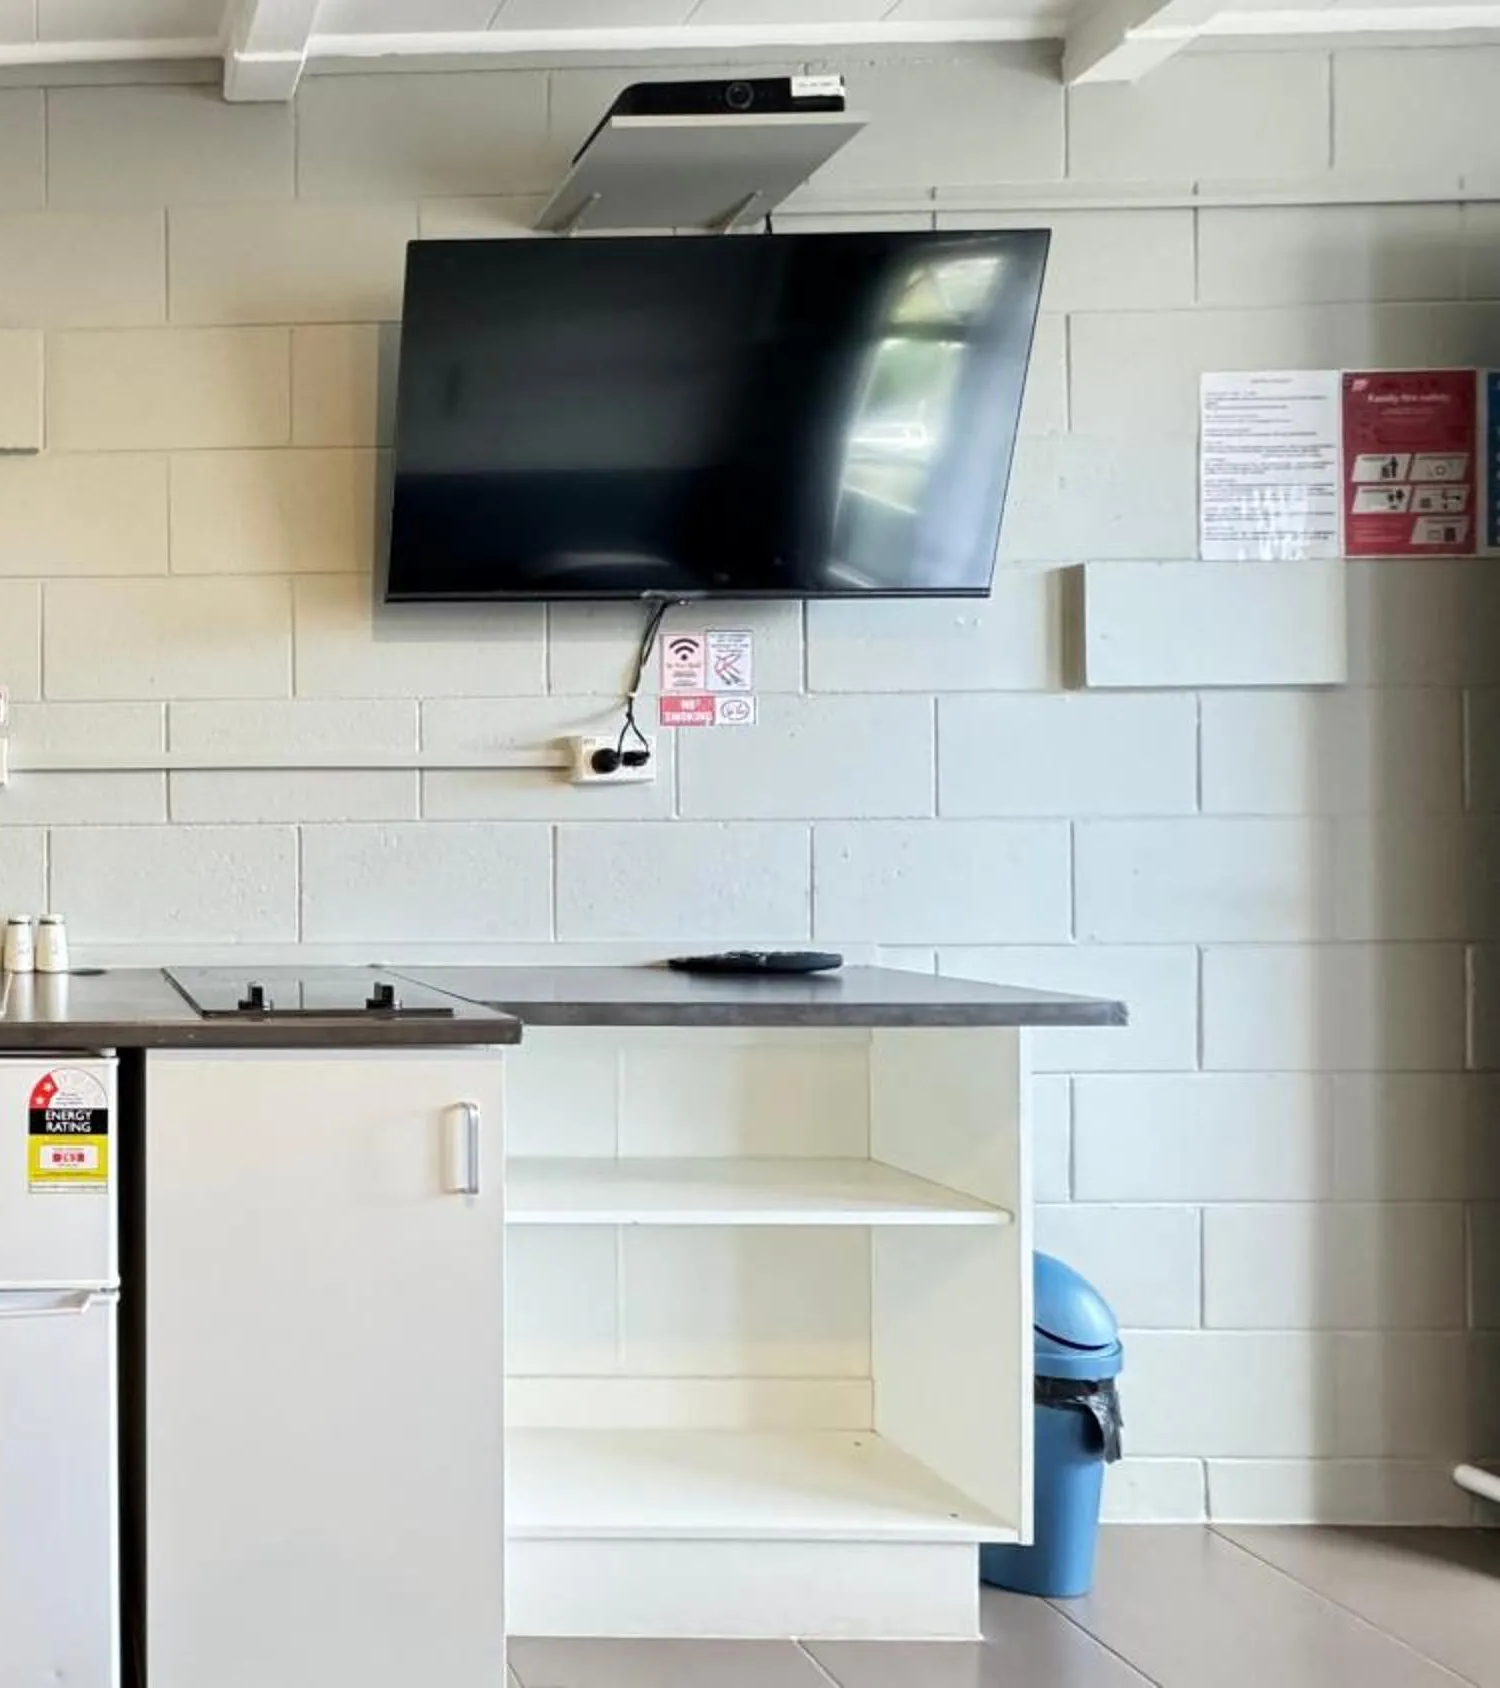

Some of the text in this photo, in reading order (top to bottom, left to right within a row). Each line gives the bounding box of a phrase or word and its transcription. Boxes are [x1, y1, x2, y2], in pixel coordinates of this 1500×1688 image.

[664, 711, 713, 722] SMOKING
[45, 1109, 93, 1121] ENERGY
[45, 1121, 92, 1133] RATING
